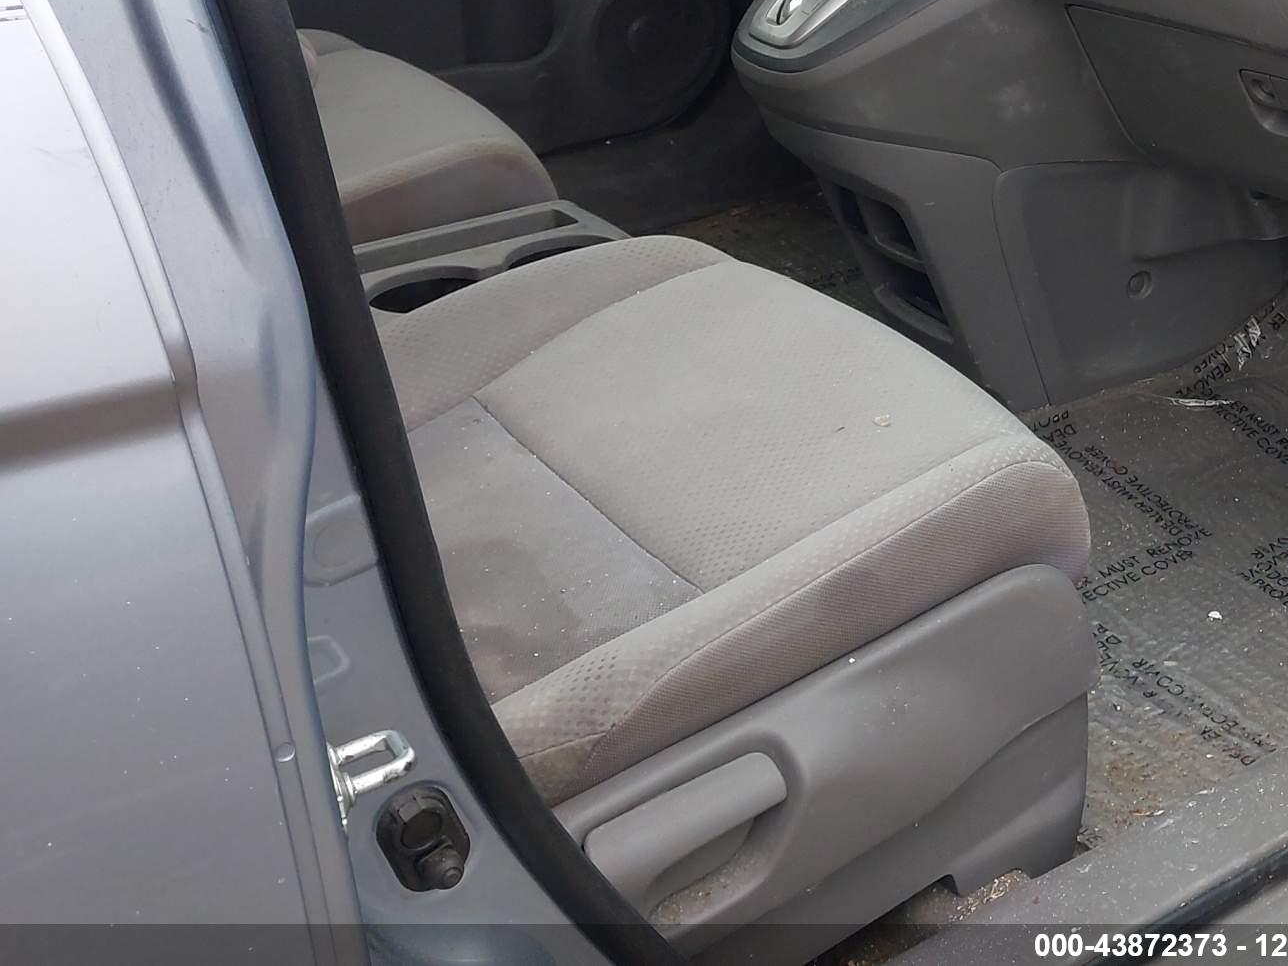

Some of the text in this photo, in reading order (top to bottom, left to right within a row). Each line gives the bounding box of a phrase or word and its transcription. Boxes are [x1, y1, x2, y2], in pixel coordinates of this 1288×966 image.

[1081, 572, 1141, 604] ECTIVE
[1141, 550, 1196, 576] COVER
[1098, 555, 1141, 579] MUST
